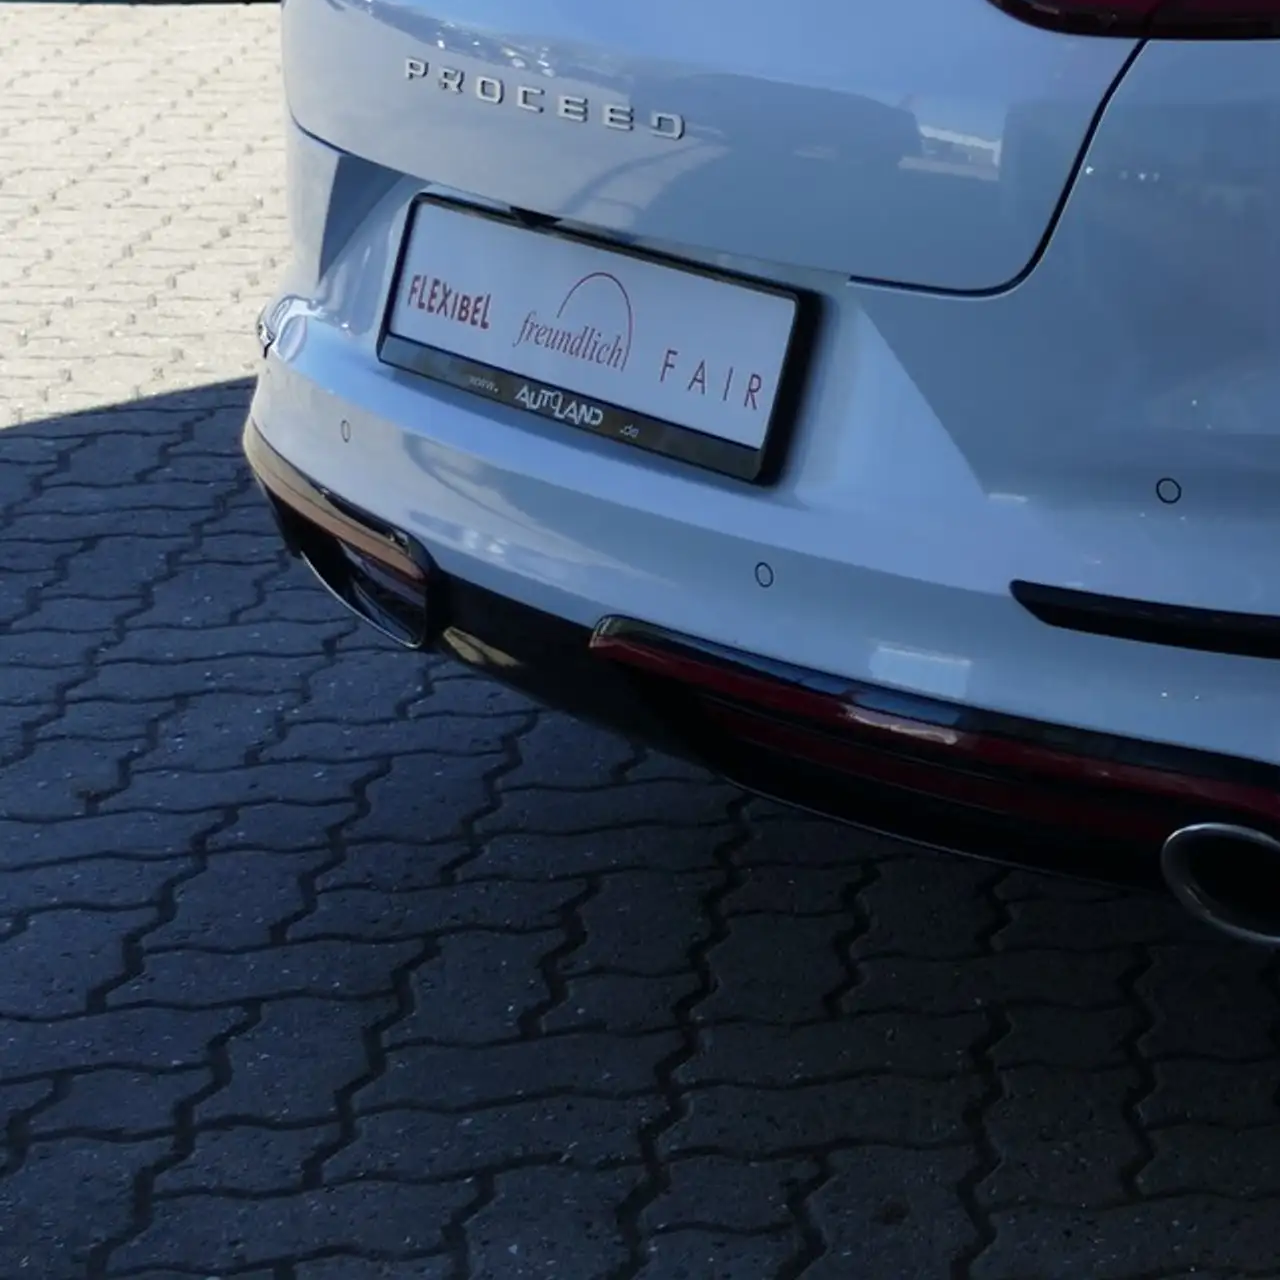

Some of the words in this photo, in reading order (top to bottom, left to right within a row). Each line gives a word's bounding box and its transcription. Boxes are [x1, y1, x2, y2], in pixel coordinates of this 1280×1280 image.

[404, 57, 686, 140] PROCEED
[407, 274, 492, 330] FLEXIBEL
[513, 310, 624, 369] freundlich
[660, 349, 762, 410] FAIR
[514, 384, 604, 426] AUTOLAND
